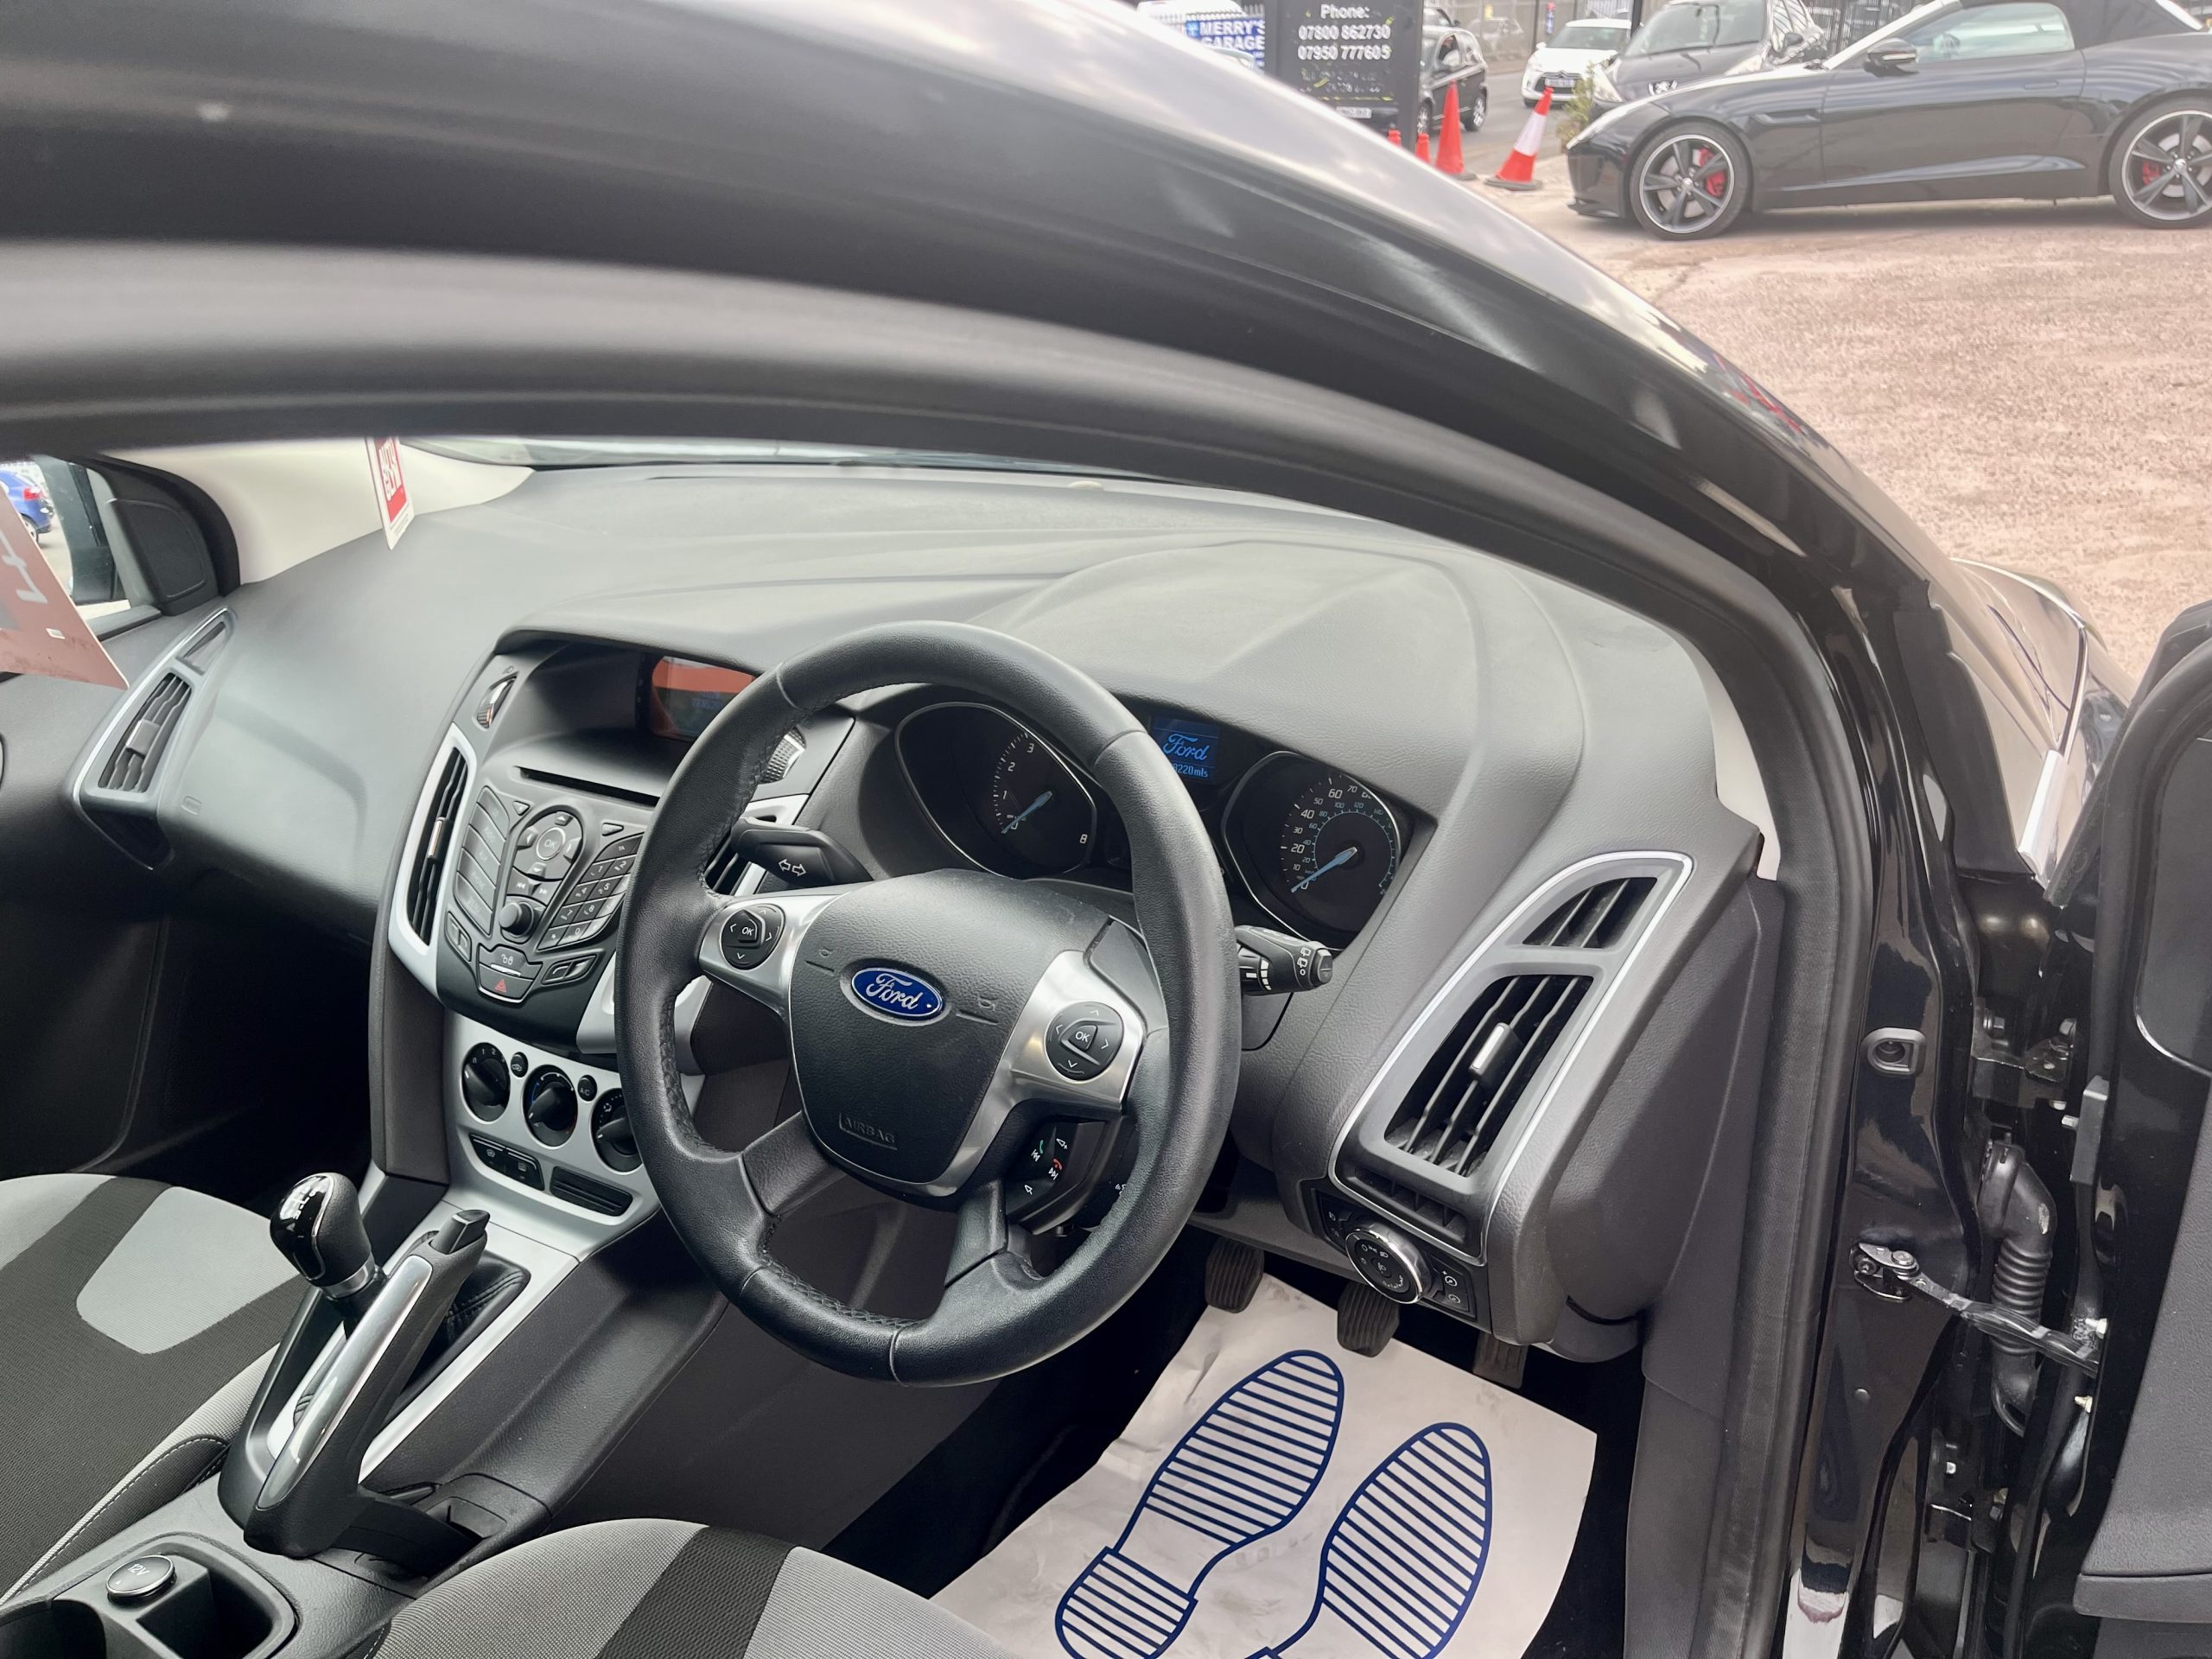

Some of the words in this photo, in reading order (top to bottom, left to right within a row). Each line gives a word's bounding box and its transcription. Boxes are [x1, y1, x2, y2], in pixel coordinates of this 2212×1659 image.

[1320, 3, 1370, 19] Phone:
[1298, 24, 1339, 40] 07800
[1340, 23, 1391, 40] 862730
[1297, 45, 1338, 60] 07950
[1340, 44, 1392, 60] 777605
[1162, 733, 1210, 760] Ford
[1007, 761, 1015, 772] 2
[1328, 788, 1343, 799] 60
[1347, 785, 1357, 793] 70
[1300, 809, 1314, 819] 40
[1293, 826, 1303, 835] 30
[544, 838, 556, 849] OK
[1290, 843, 1305, 854] 20
[741, 926, 754, 936] OK
[865, 973, 924, 1010] Ford
[1075, 1031, 1090, 1043] OK
[127, 1563, 150, 1576] 12V
